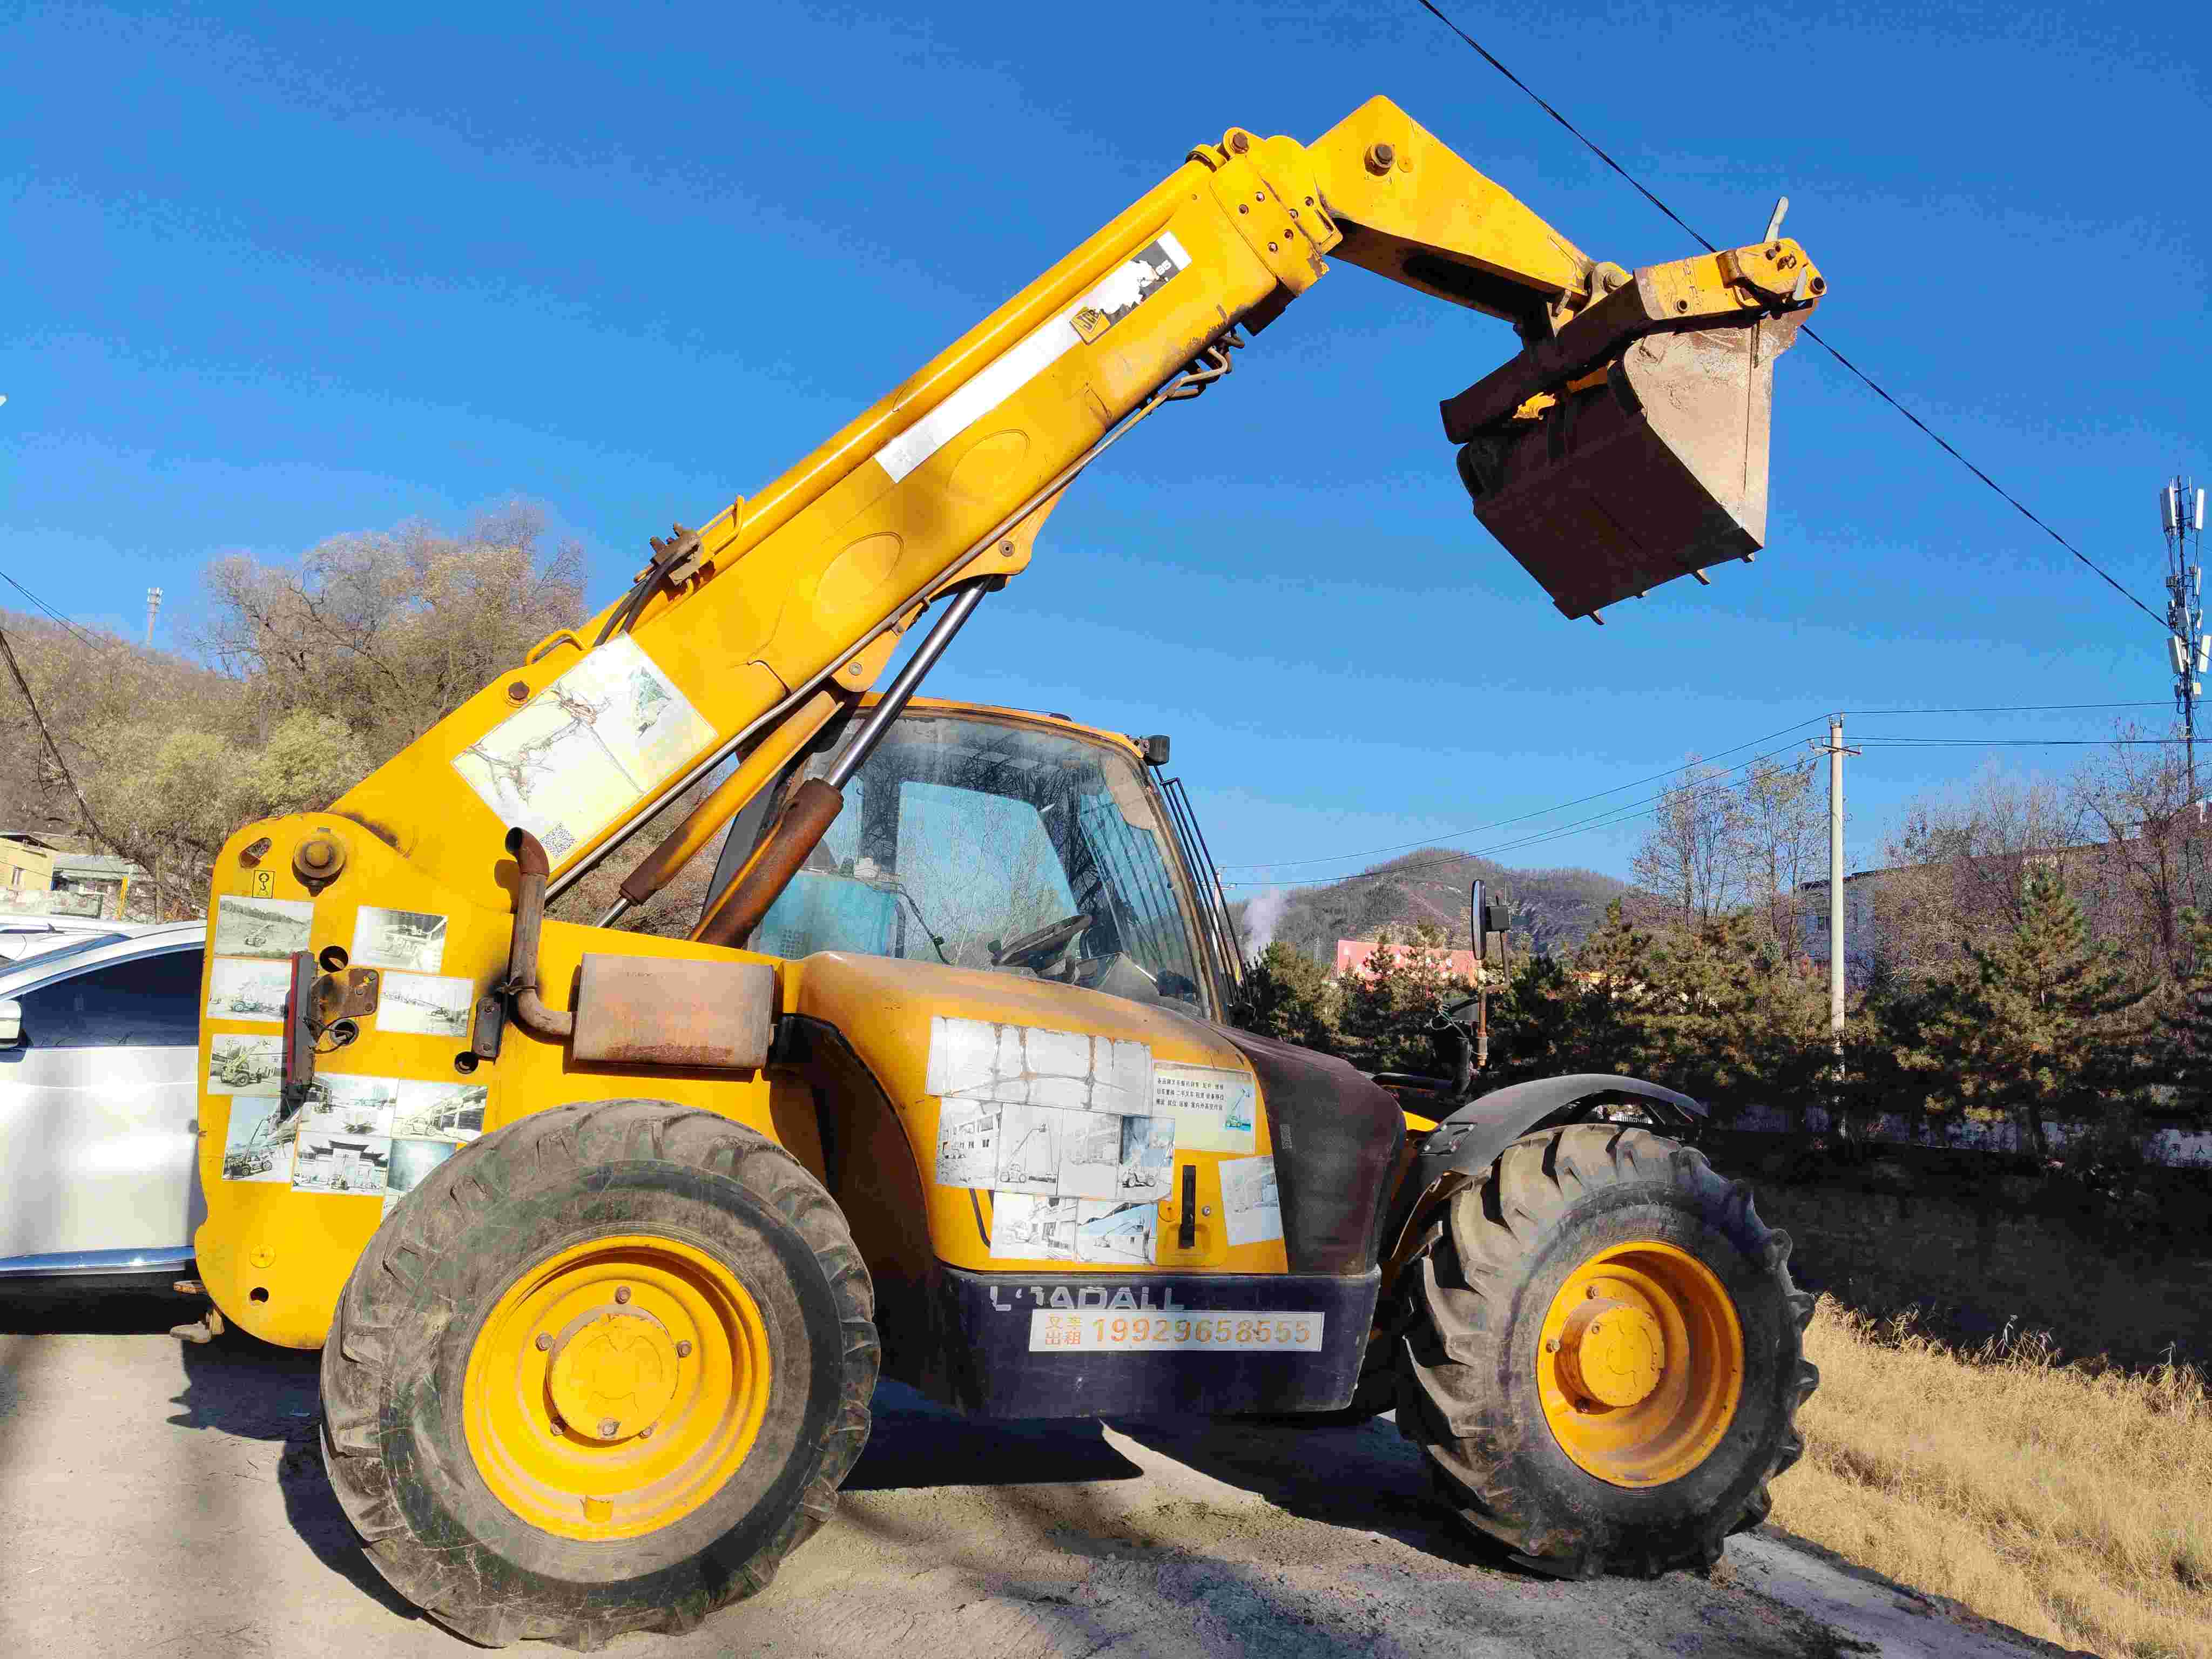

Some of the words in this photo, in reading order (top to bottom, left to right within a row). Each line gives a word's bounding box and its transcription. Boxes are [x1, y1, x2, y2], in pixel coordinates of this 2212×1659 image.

[1076, 310, 1100, 331] JCB
[990, 1286, 1185, 1311] LADALL
[1046, 1315, 1082, 1329] 叉车
[1092, 1318, 1311, 1343] 19929658555
[1045, 1331, 1081, 1345] 出租
